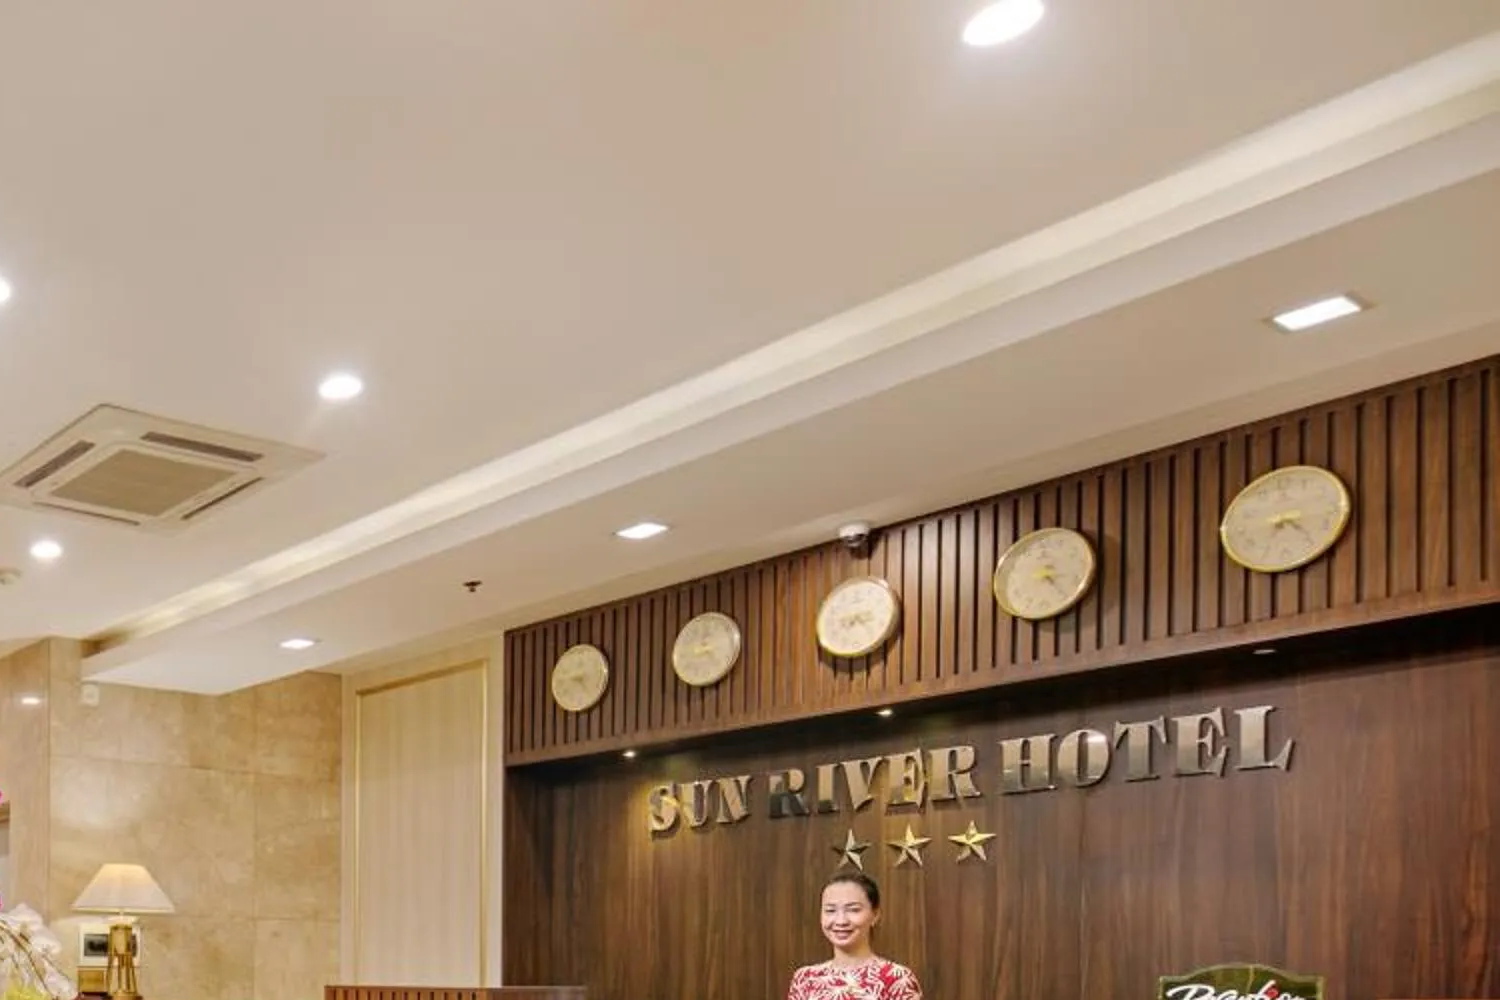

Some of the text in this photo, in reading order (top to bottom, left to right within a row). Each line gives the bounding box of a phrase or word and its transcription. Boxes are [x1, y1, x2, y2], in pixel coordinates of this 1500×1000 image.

[650, 705, 1296, 832] SUN RIVER HOTEL
